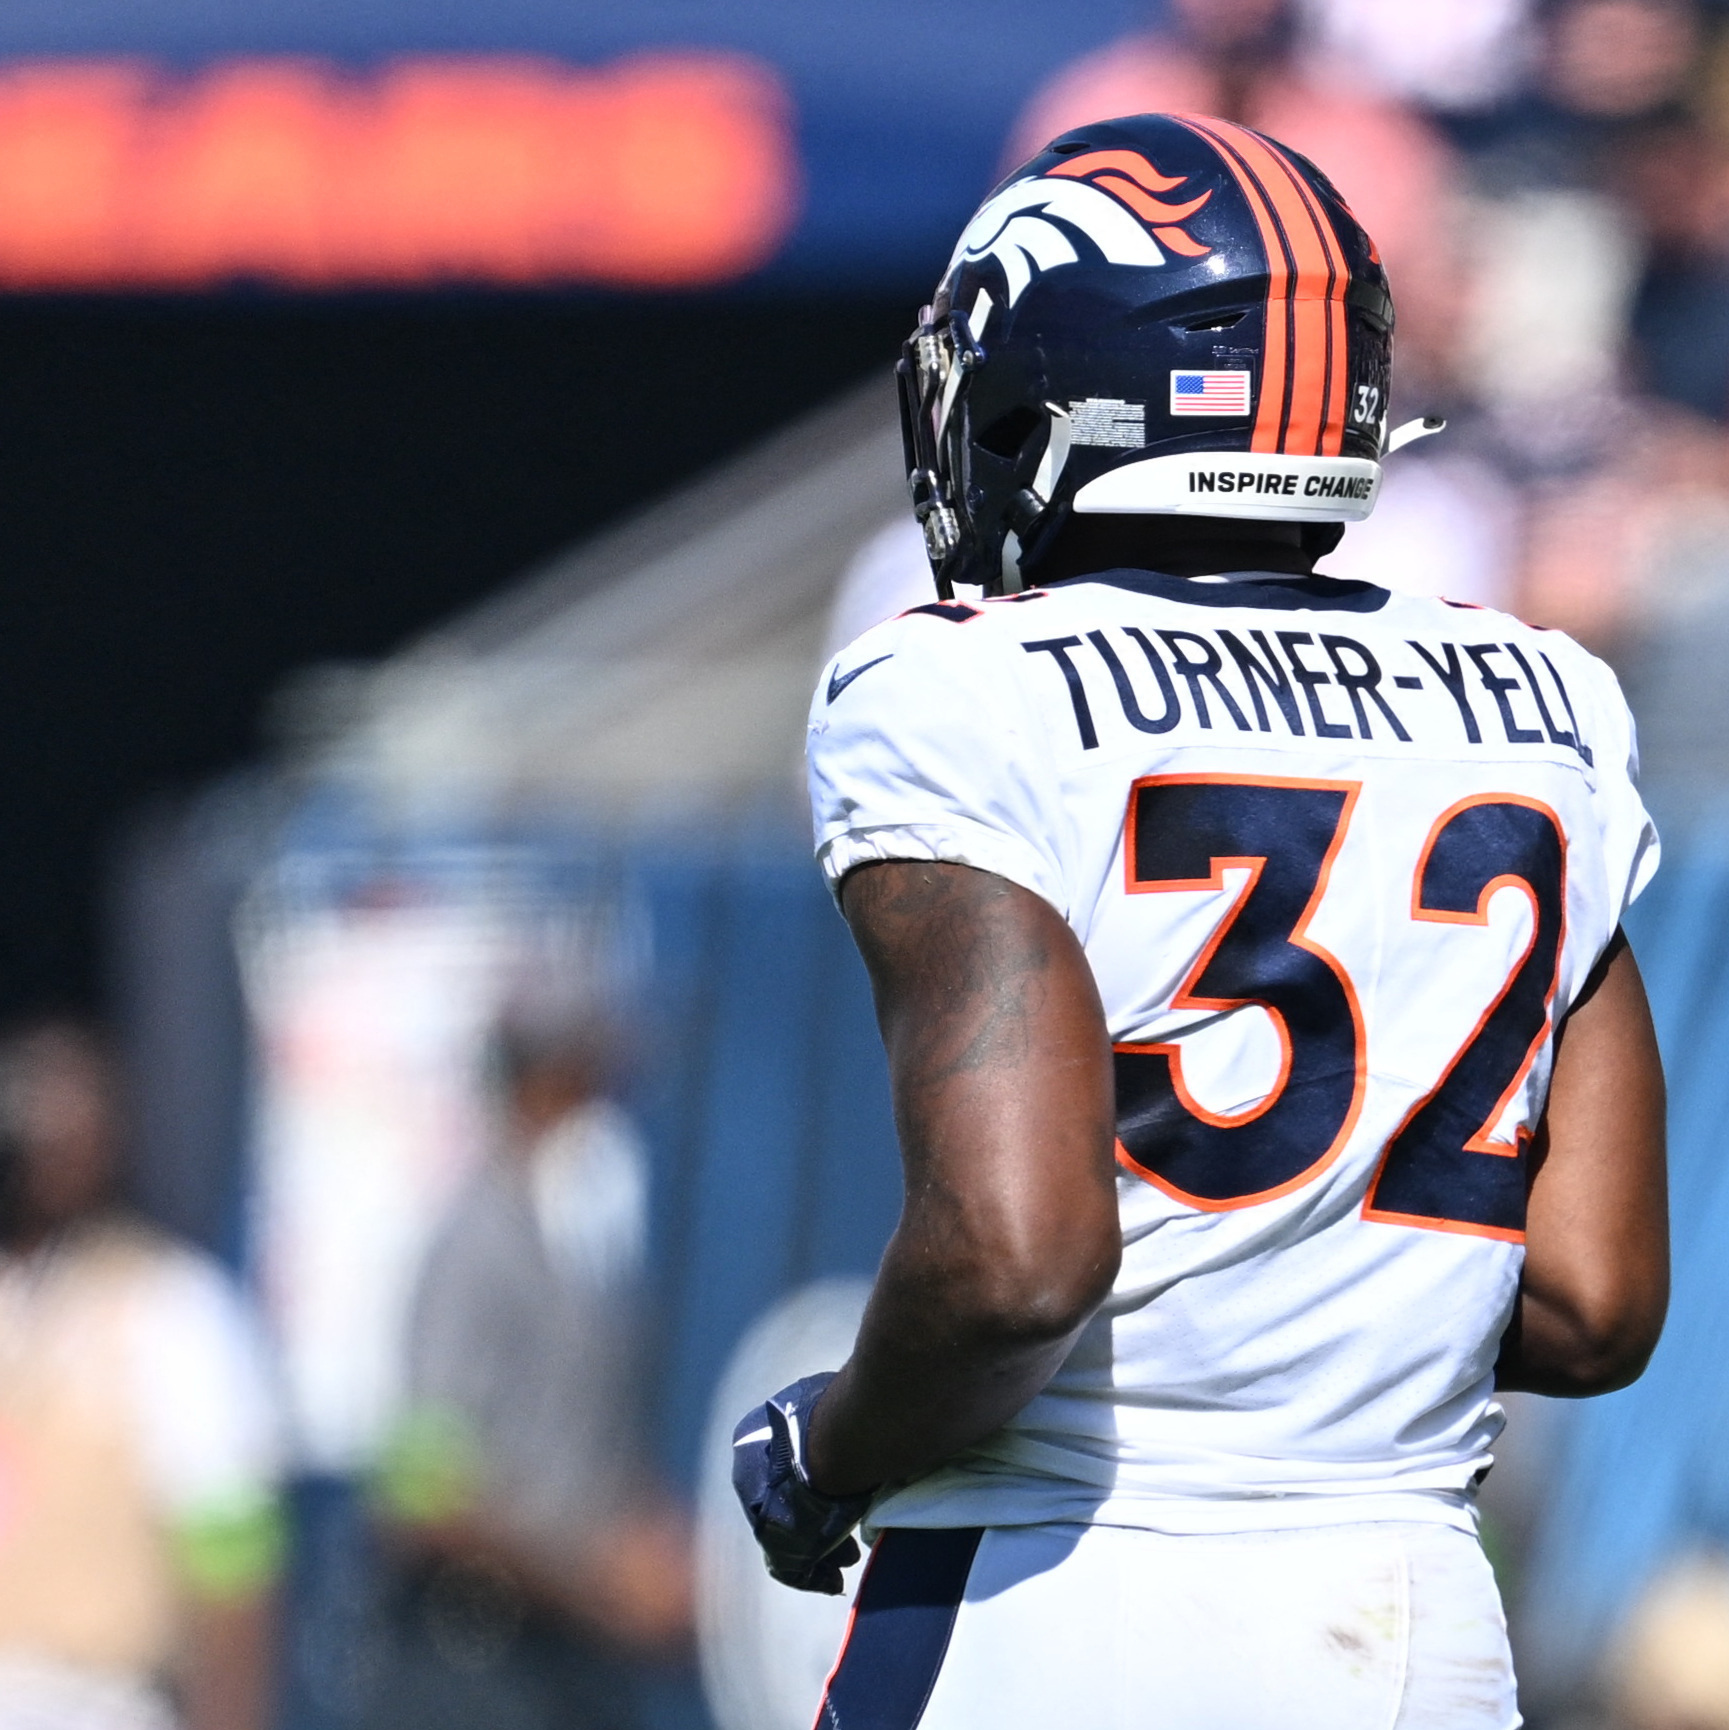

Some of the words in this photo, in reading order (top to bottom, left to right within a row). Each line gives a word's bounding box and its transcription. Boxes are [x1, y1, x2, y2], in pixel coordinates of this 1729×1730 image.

[1354, 385, 1379, 424] 32
[1188, 471, 1299, 495] INSPIRE
[1303, 475, 1374, 500] CHANGE
[1021, 627, 1594, 768] TURNER-YELL
[1114, 772, 1567, 1243] 32
